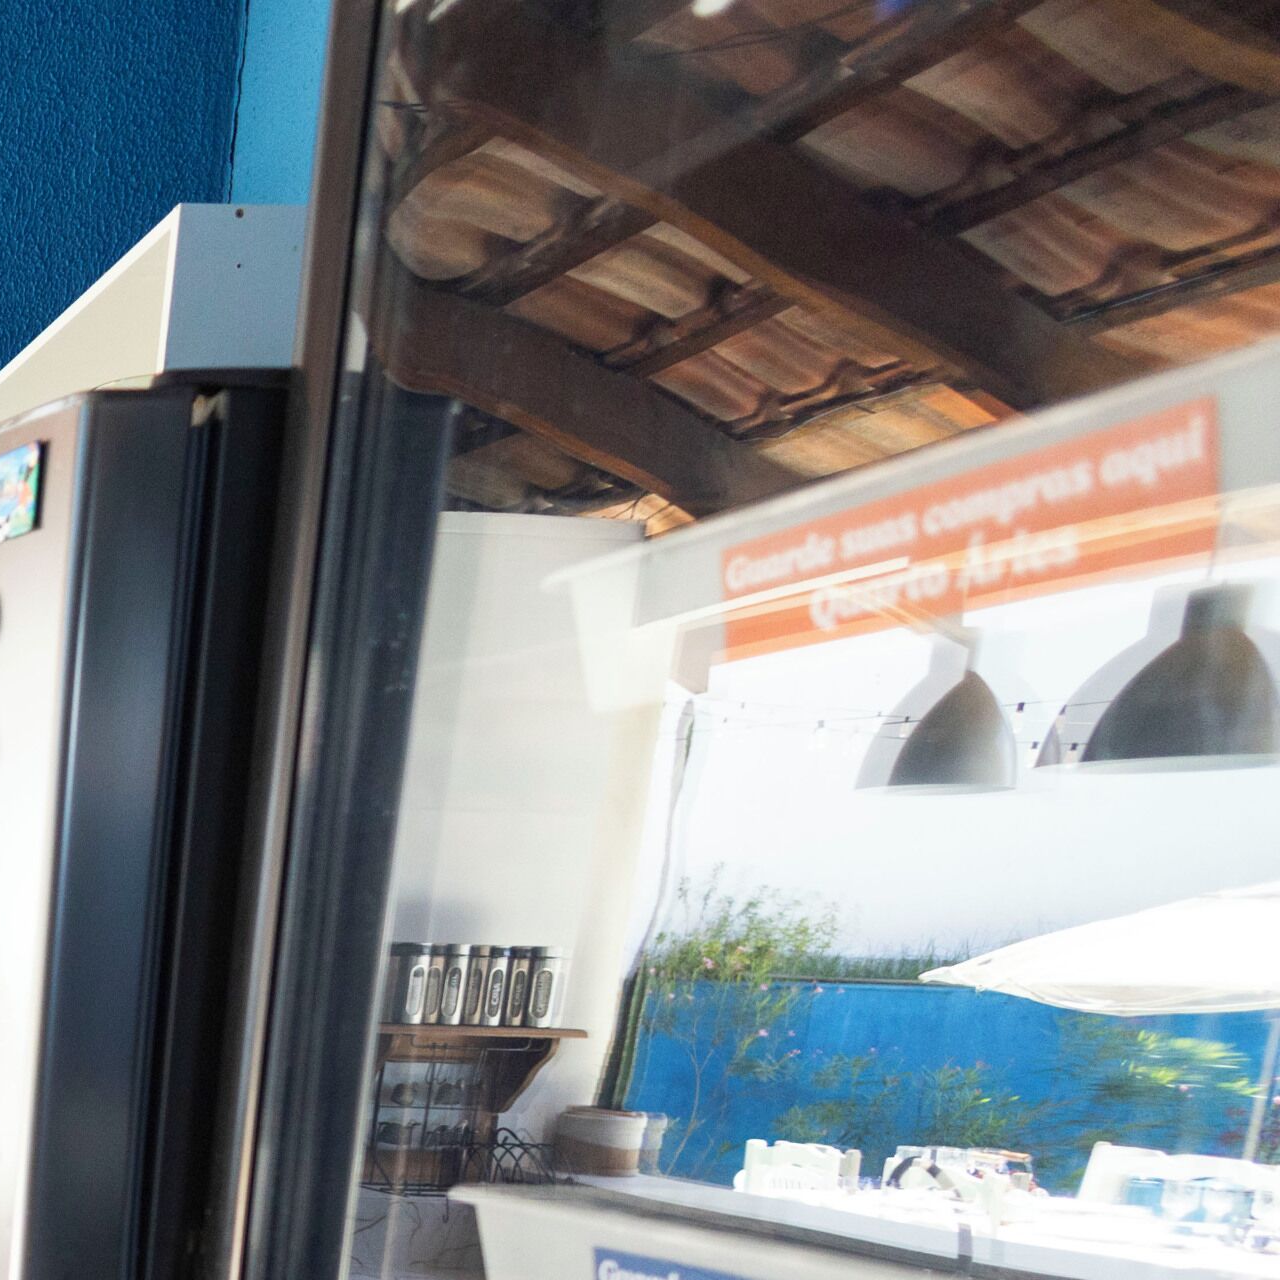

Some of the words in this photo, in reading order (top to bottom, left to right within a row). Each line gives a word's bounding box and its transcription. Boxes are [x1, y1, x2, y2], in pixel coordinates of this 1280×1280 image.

[726, 532, 835, 592] Guarde
[841, 511, 917, 561] suas
[922, 460, 1095, 537] compras
